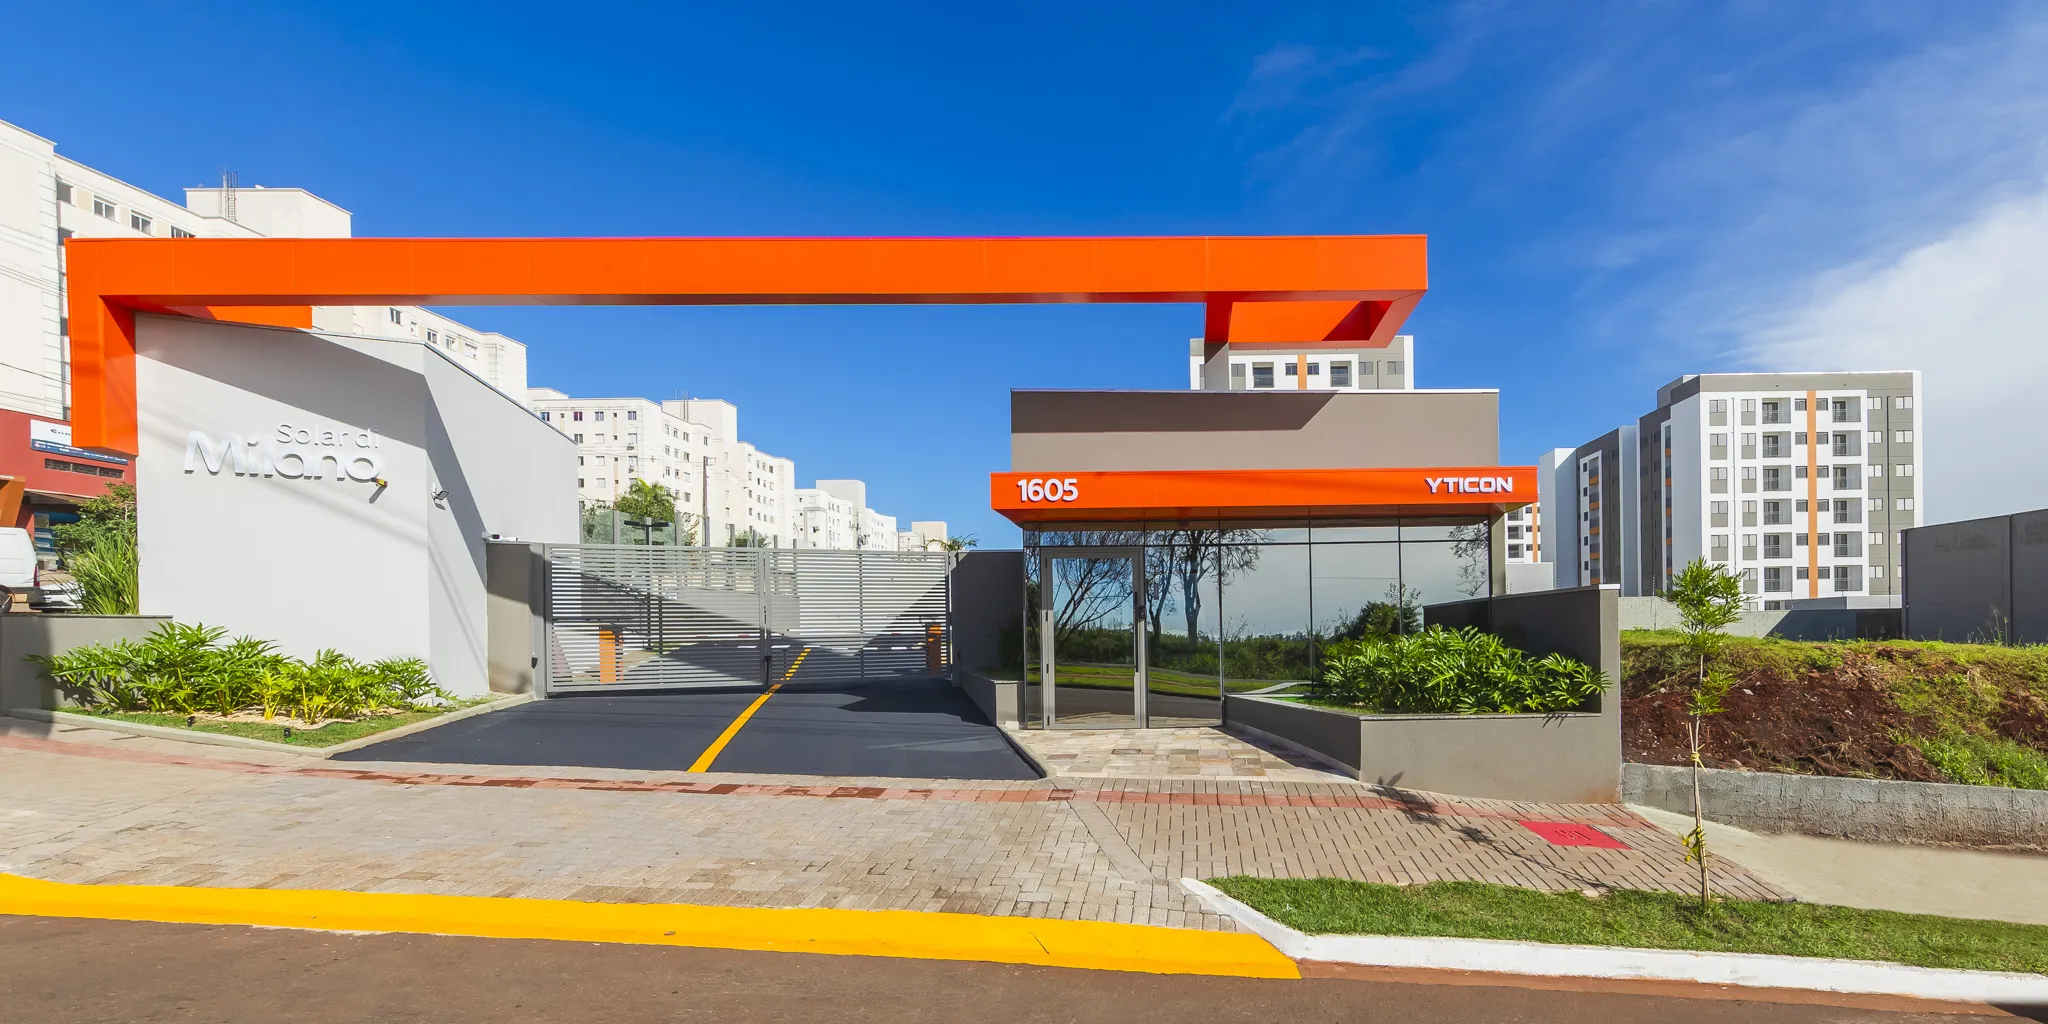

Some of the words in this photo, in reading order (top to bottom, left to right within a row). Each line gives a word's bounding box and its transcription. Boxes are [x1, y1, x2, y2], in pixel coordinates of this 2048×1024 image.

[276, 423, 348, 446] Solar
[355, 427, 380, 449] di
[184, 430, 382, 483] Milano
[1016, 478, 1079, 502] 1605
[1424, 476, 1513, 494] YTICON
